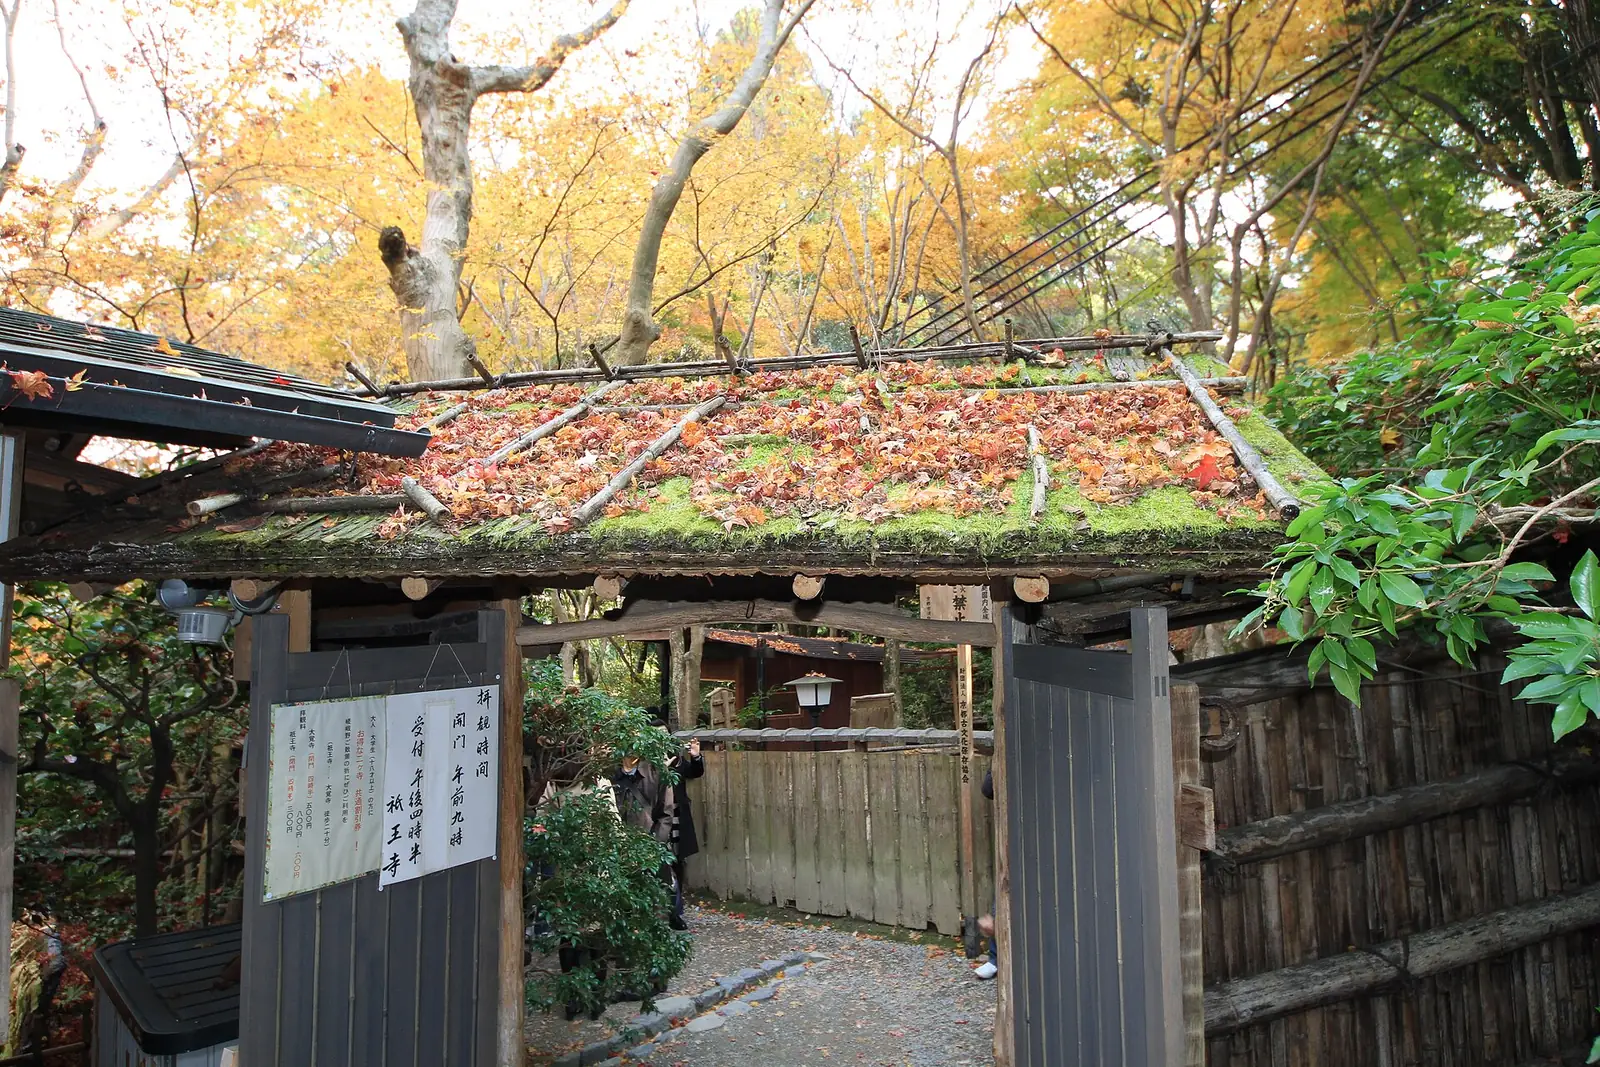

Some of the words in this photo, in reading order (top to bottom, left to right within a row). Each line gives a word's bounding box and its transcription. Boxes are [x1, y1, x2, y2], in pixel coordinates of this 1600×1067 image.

[411, 715, 425, 757] 受付
[453, 712, 466, 749] 開門
[475, 688, 492, 778] 拝観時間
[960, 700, 969, 783] 京都古文化保存協会
[408, 768, 425, 865] 午後四時半
[450, 764, 465, 847] 午前九時
